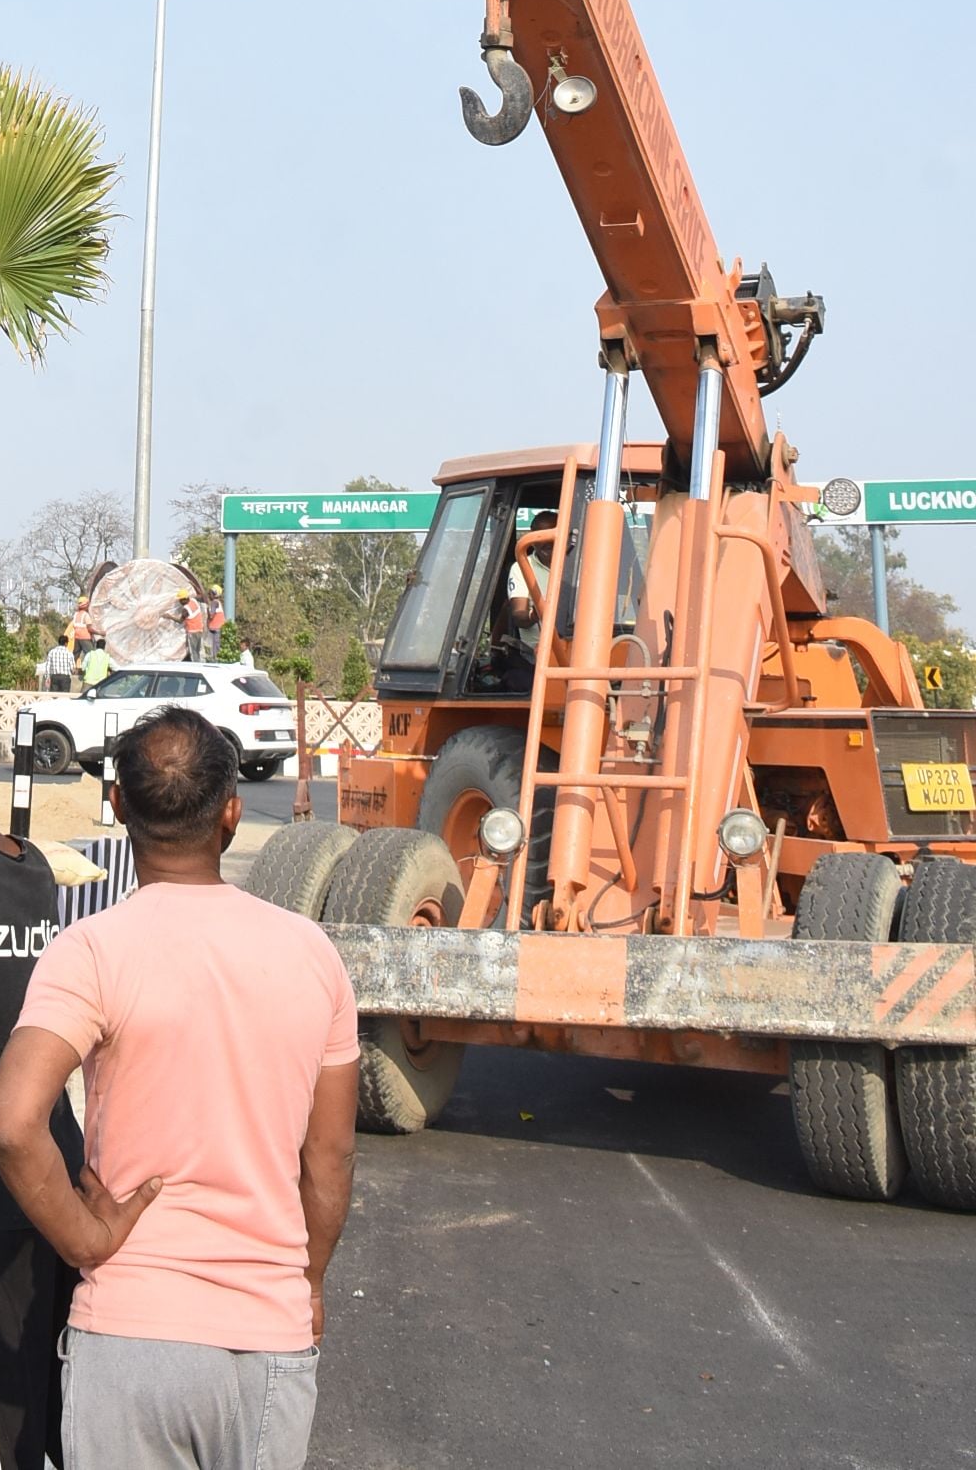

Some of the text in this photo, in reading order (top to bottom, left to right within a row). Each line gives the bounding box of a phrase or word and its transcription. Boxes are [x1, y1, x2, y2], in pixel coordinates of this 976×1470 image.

[241, 501, 309, 515] महानगर
[322, 500, 408, 514] MAHANAGAR
[917, 769, 960, 786] UP32R
[923, 788, 965, 805] N4070
